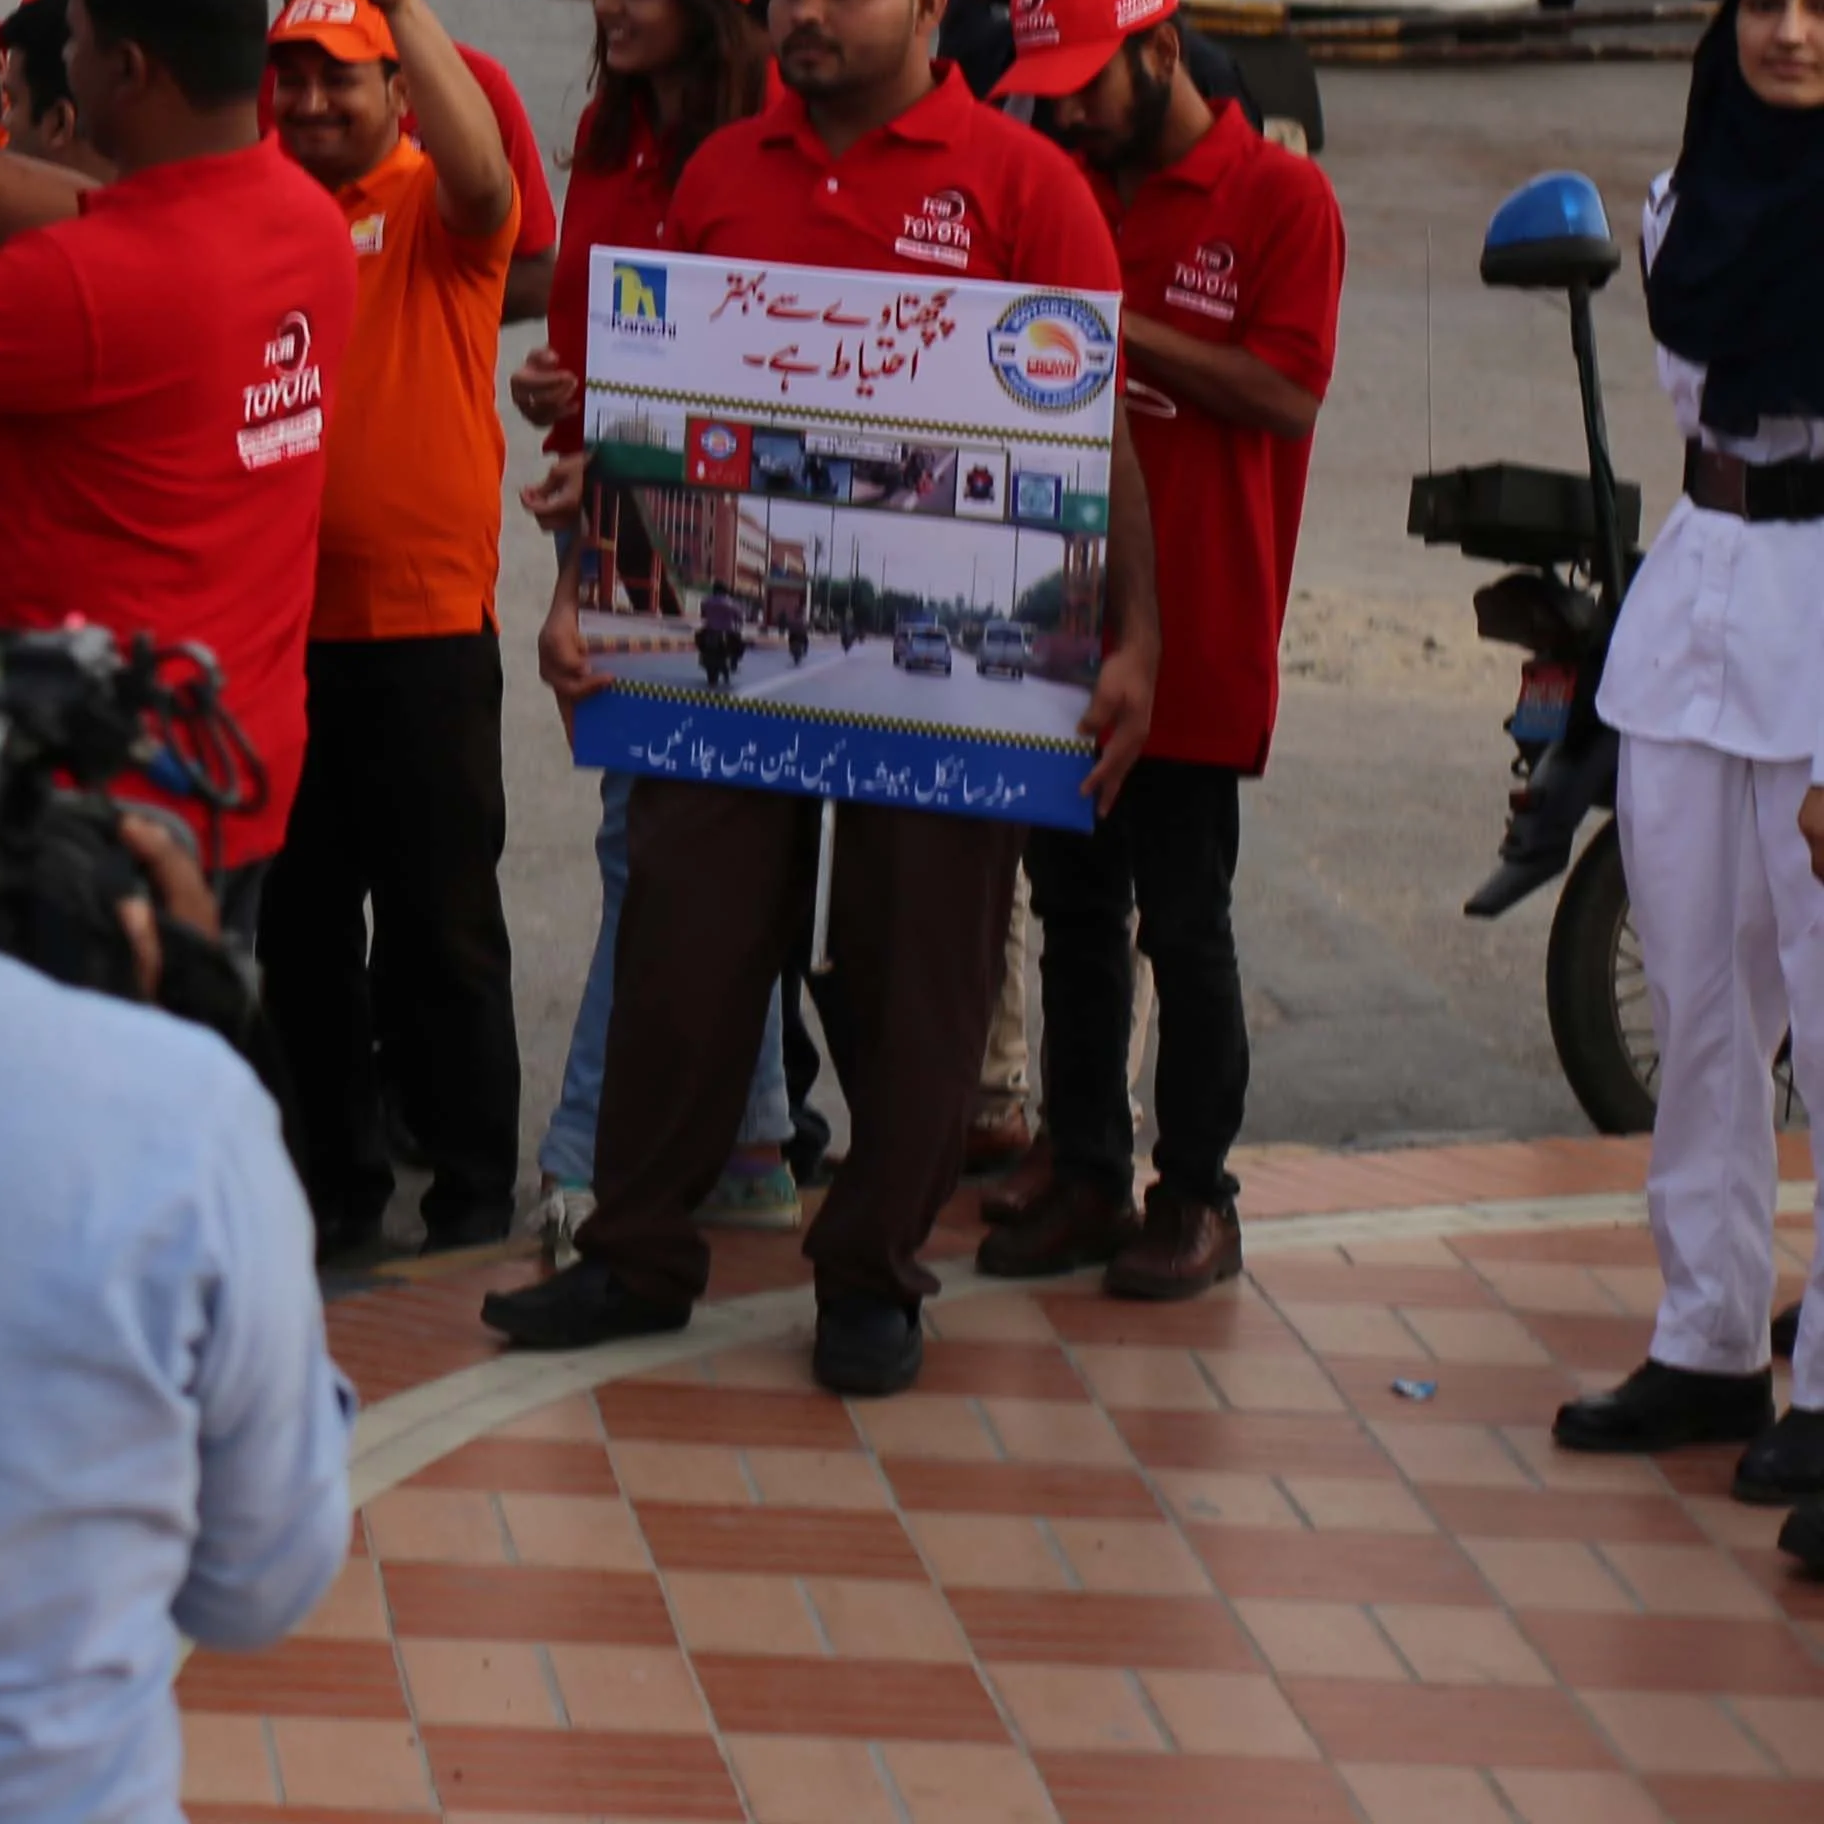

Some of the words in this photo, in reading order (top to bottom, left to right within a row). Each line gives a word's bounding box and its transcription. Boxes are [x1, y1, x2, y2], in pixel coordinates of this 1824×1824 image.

[903, 212, 971, 251] TOYOTA
[1175, 263, 1239, 301] TOYOTA
[243, 363, 322, 423] TOYOTA
